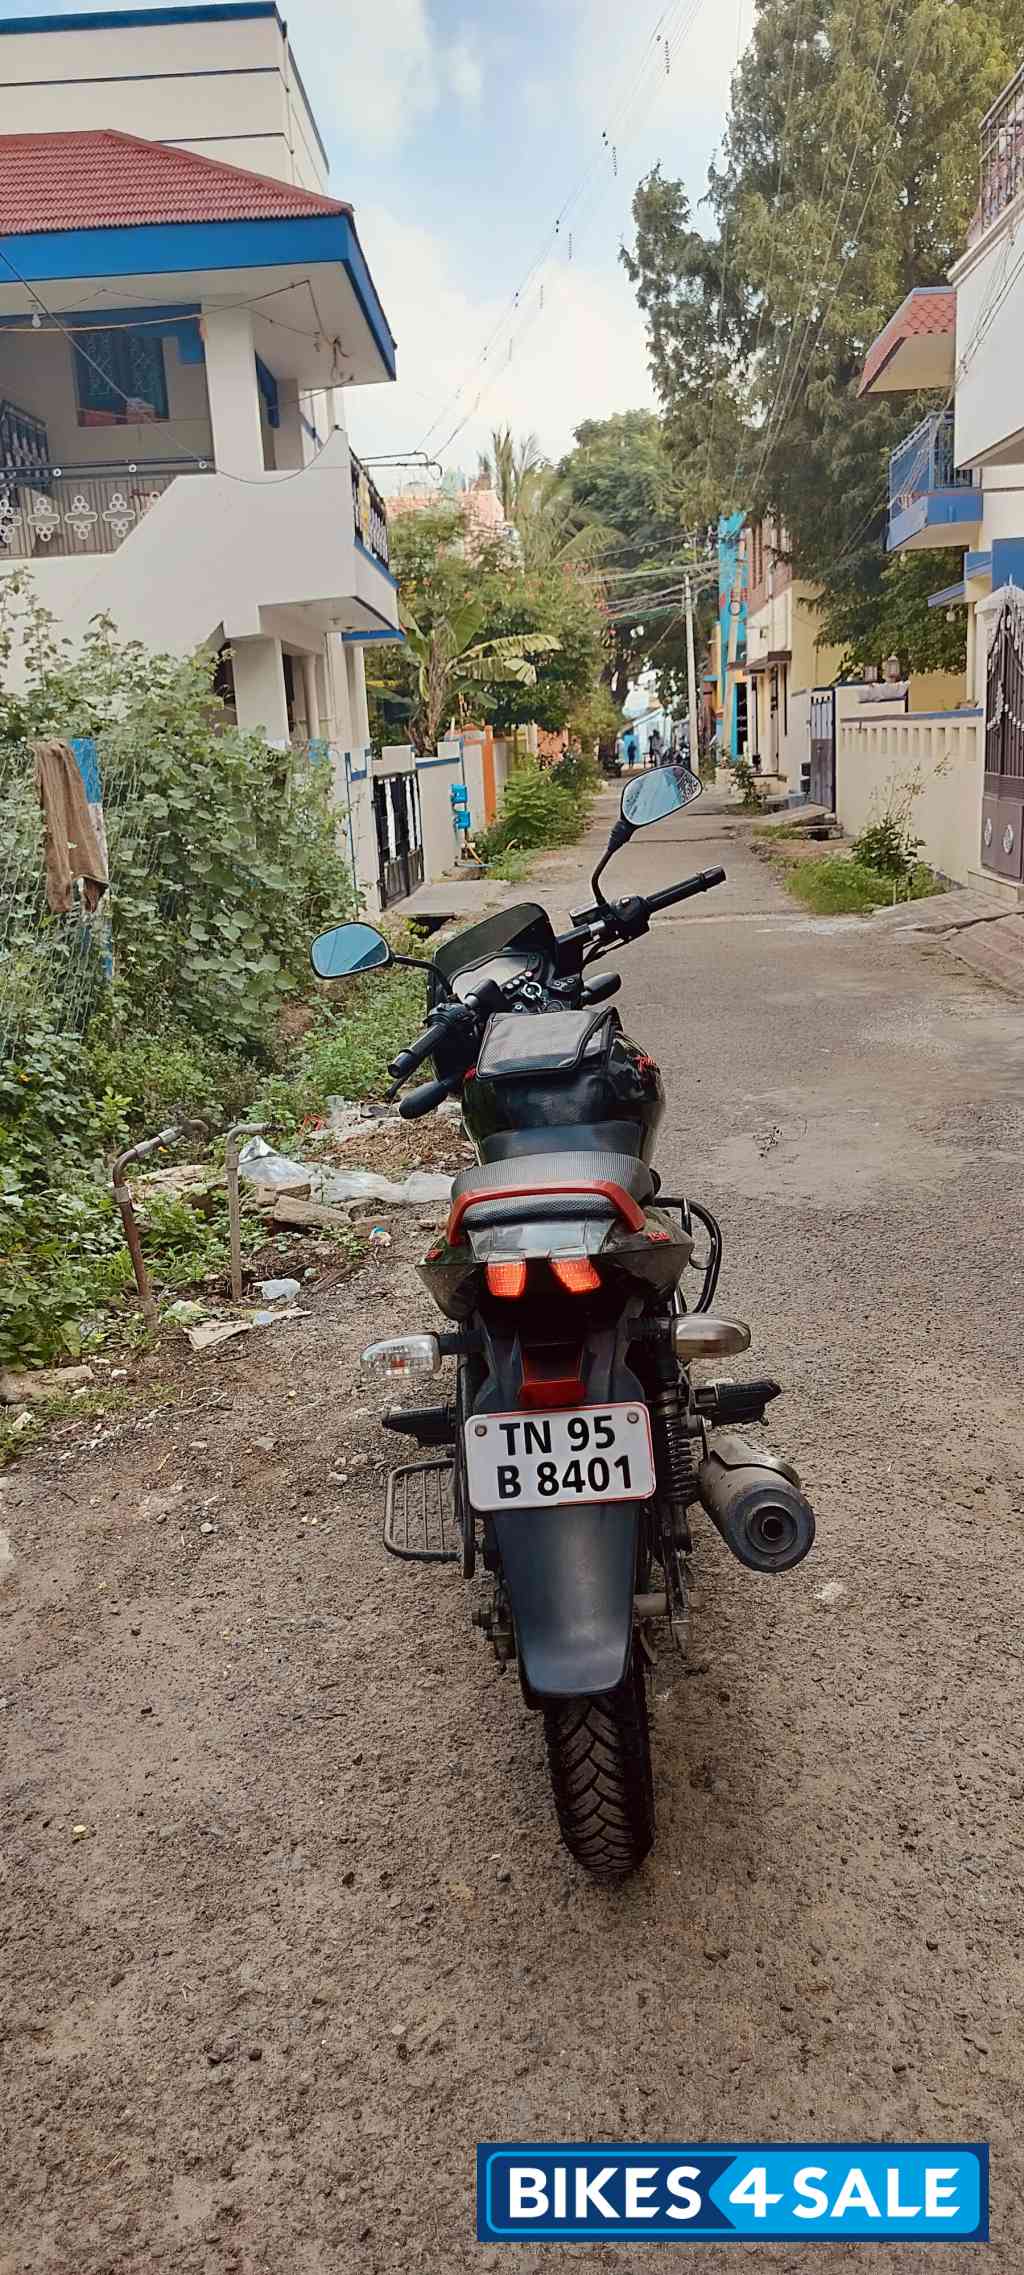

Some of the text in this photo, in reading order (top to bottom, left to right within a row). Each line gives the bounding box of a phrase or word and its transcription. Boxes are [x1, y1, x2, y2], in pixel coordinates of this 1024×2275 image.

[500, 1415, 616, 1456] TN 95
[497, 1455, 632, 1499] B 8401
